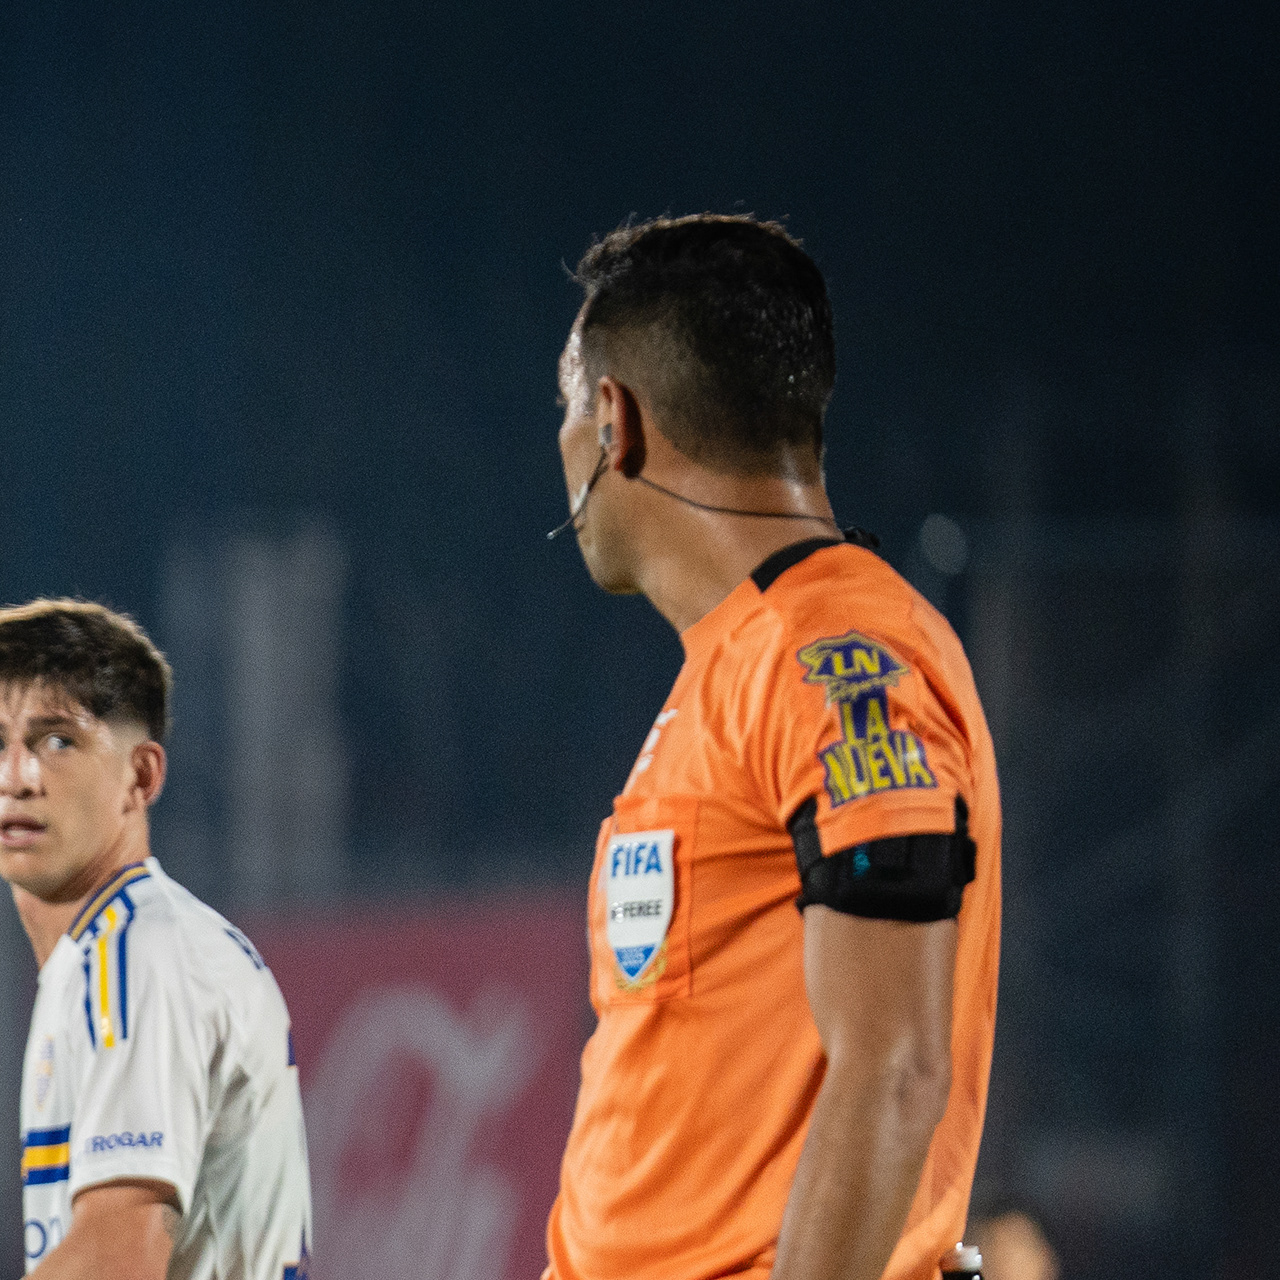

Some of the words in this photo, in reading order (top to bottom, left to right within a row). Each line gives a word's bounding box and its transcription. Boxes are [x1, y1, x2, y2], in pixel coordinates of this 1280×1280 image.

[832, 649, 880, 676] LN
[842, 699, 889, 746] LA
[825, 734, 933, 803] NUEVA
[611, 842, 663, 878] FIFA
